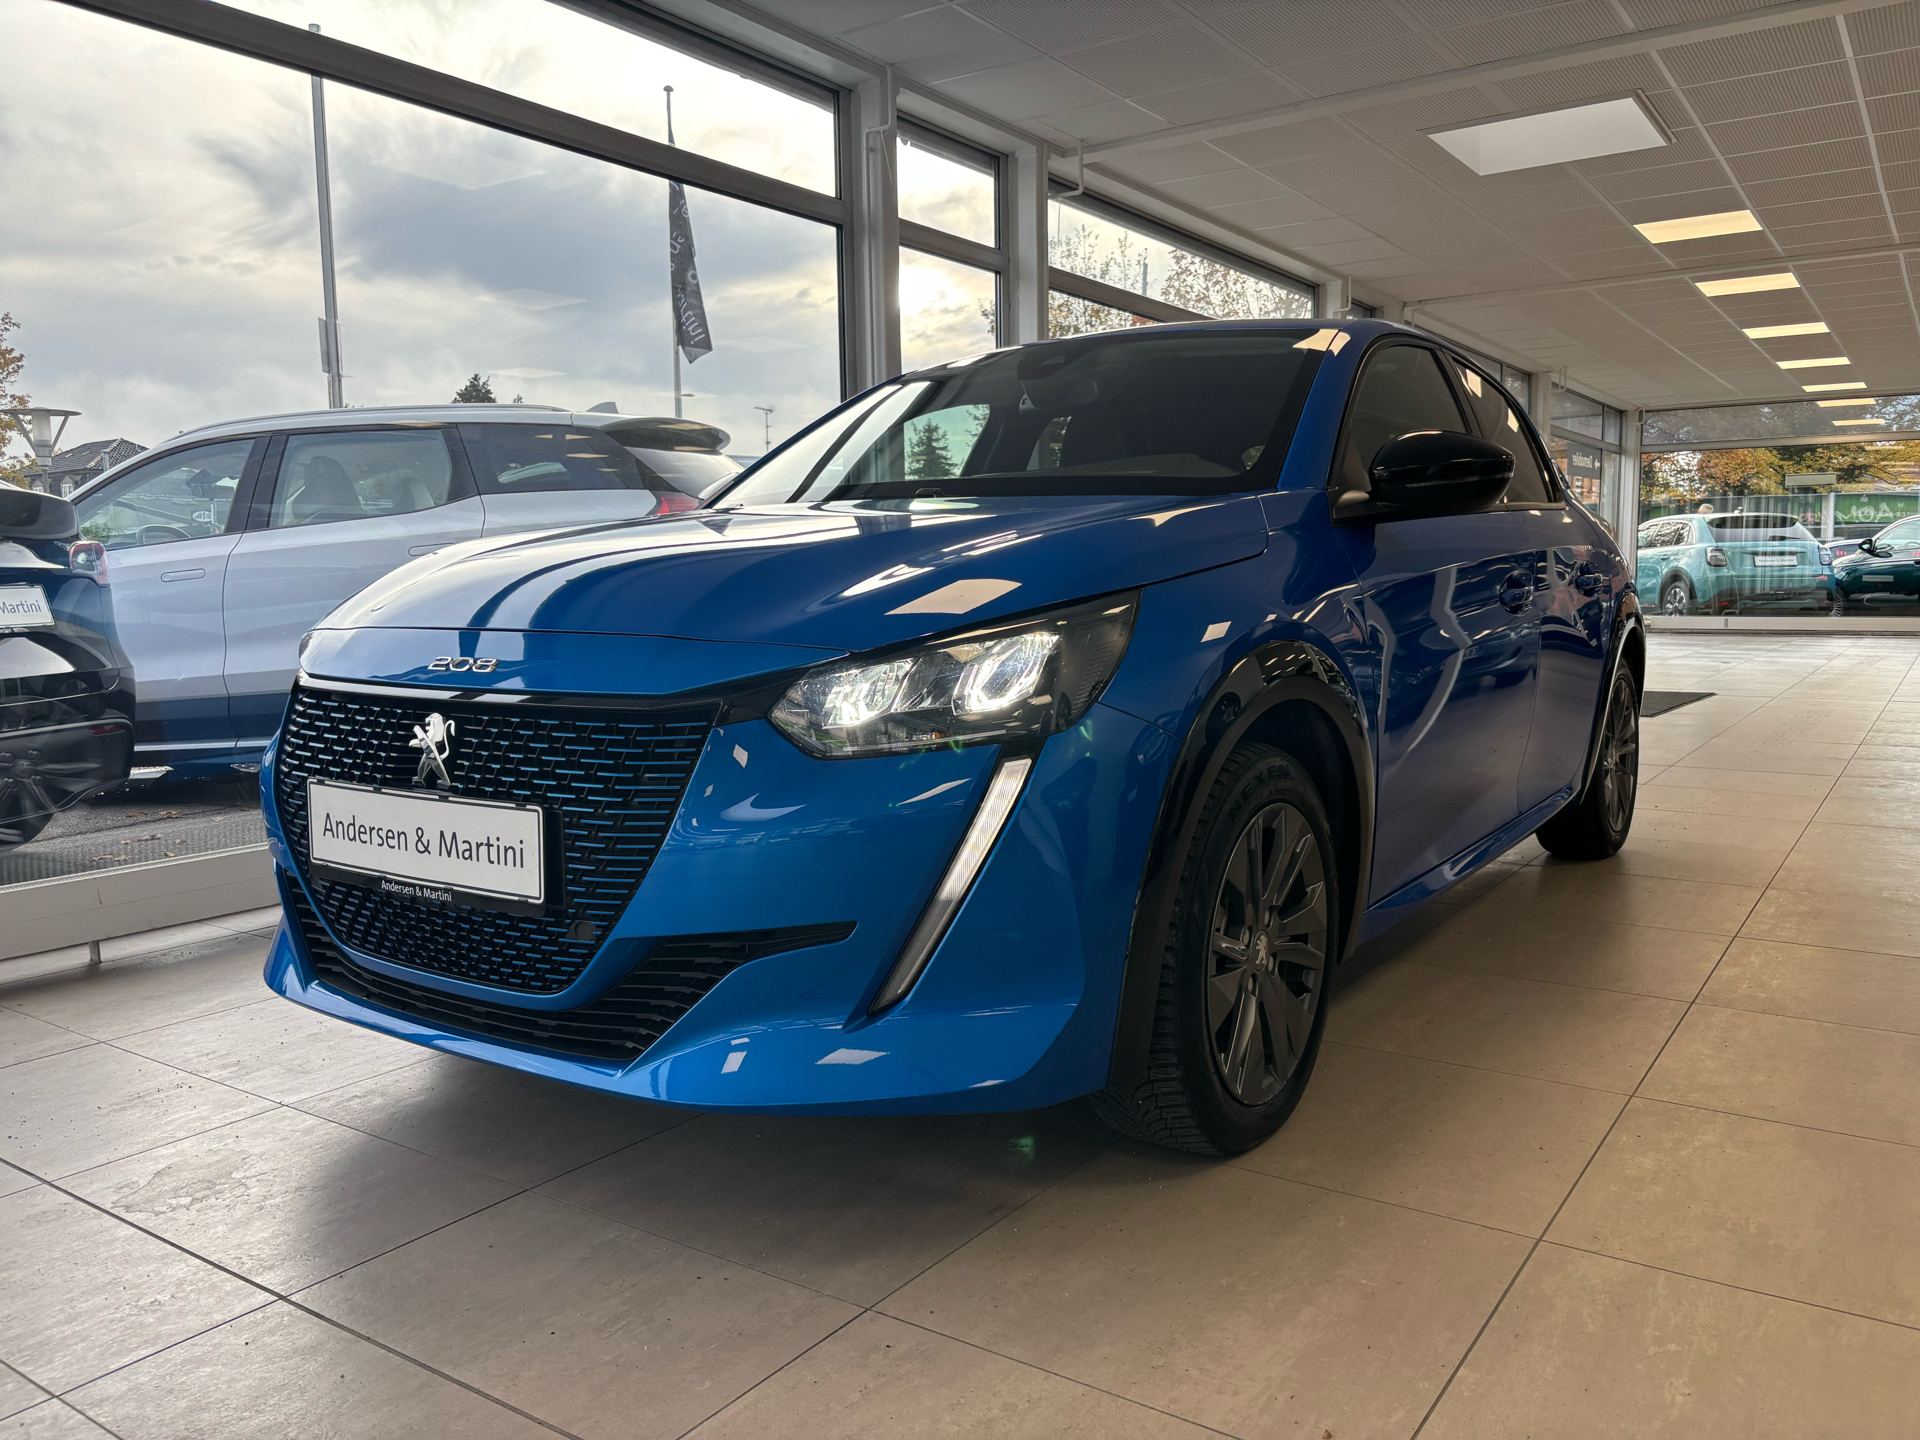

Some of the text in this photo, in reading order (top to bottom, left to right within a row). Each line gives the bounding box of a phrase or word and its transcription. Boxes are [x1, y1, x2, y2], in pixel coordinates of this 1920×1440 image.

[0, 599, 42, 614] Martini
[427, 656, 498, 673] 208
[1228, 763, 1291, 822] NEXEN
[323, 812, 524, 869] Andersen & Martini
[381, 880, 452, 901] Andersen & Martini
